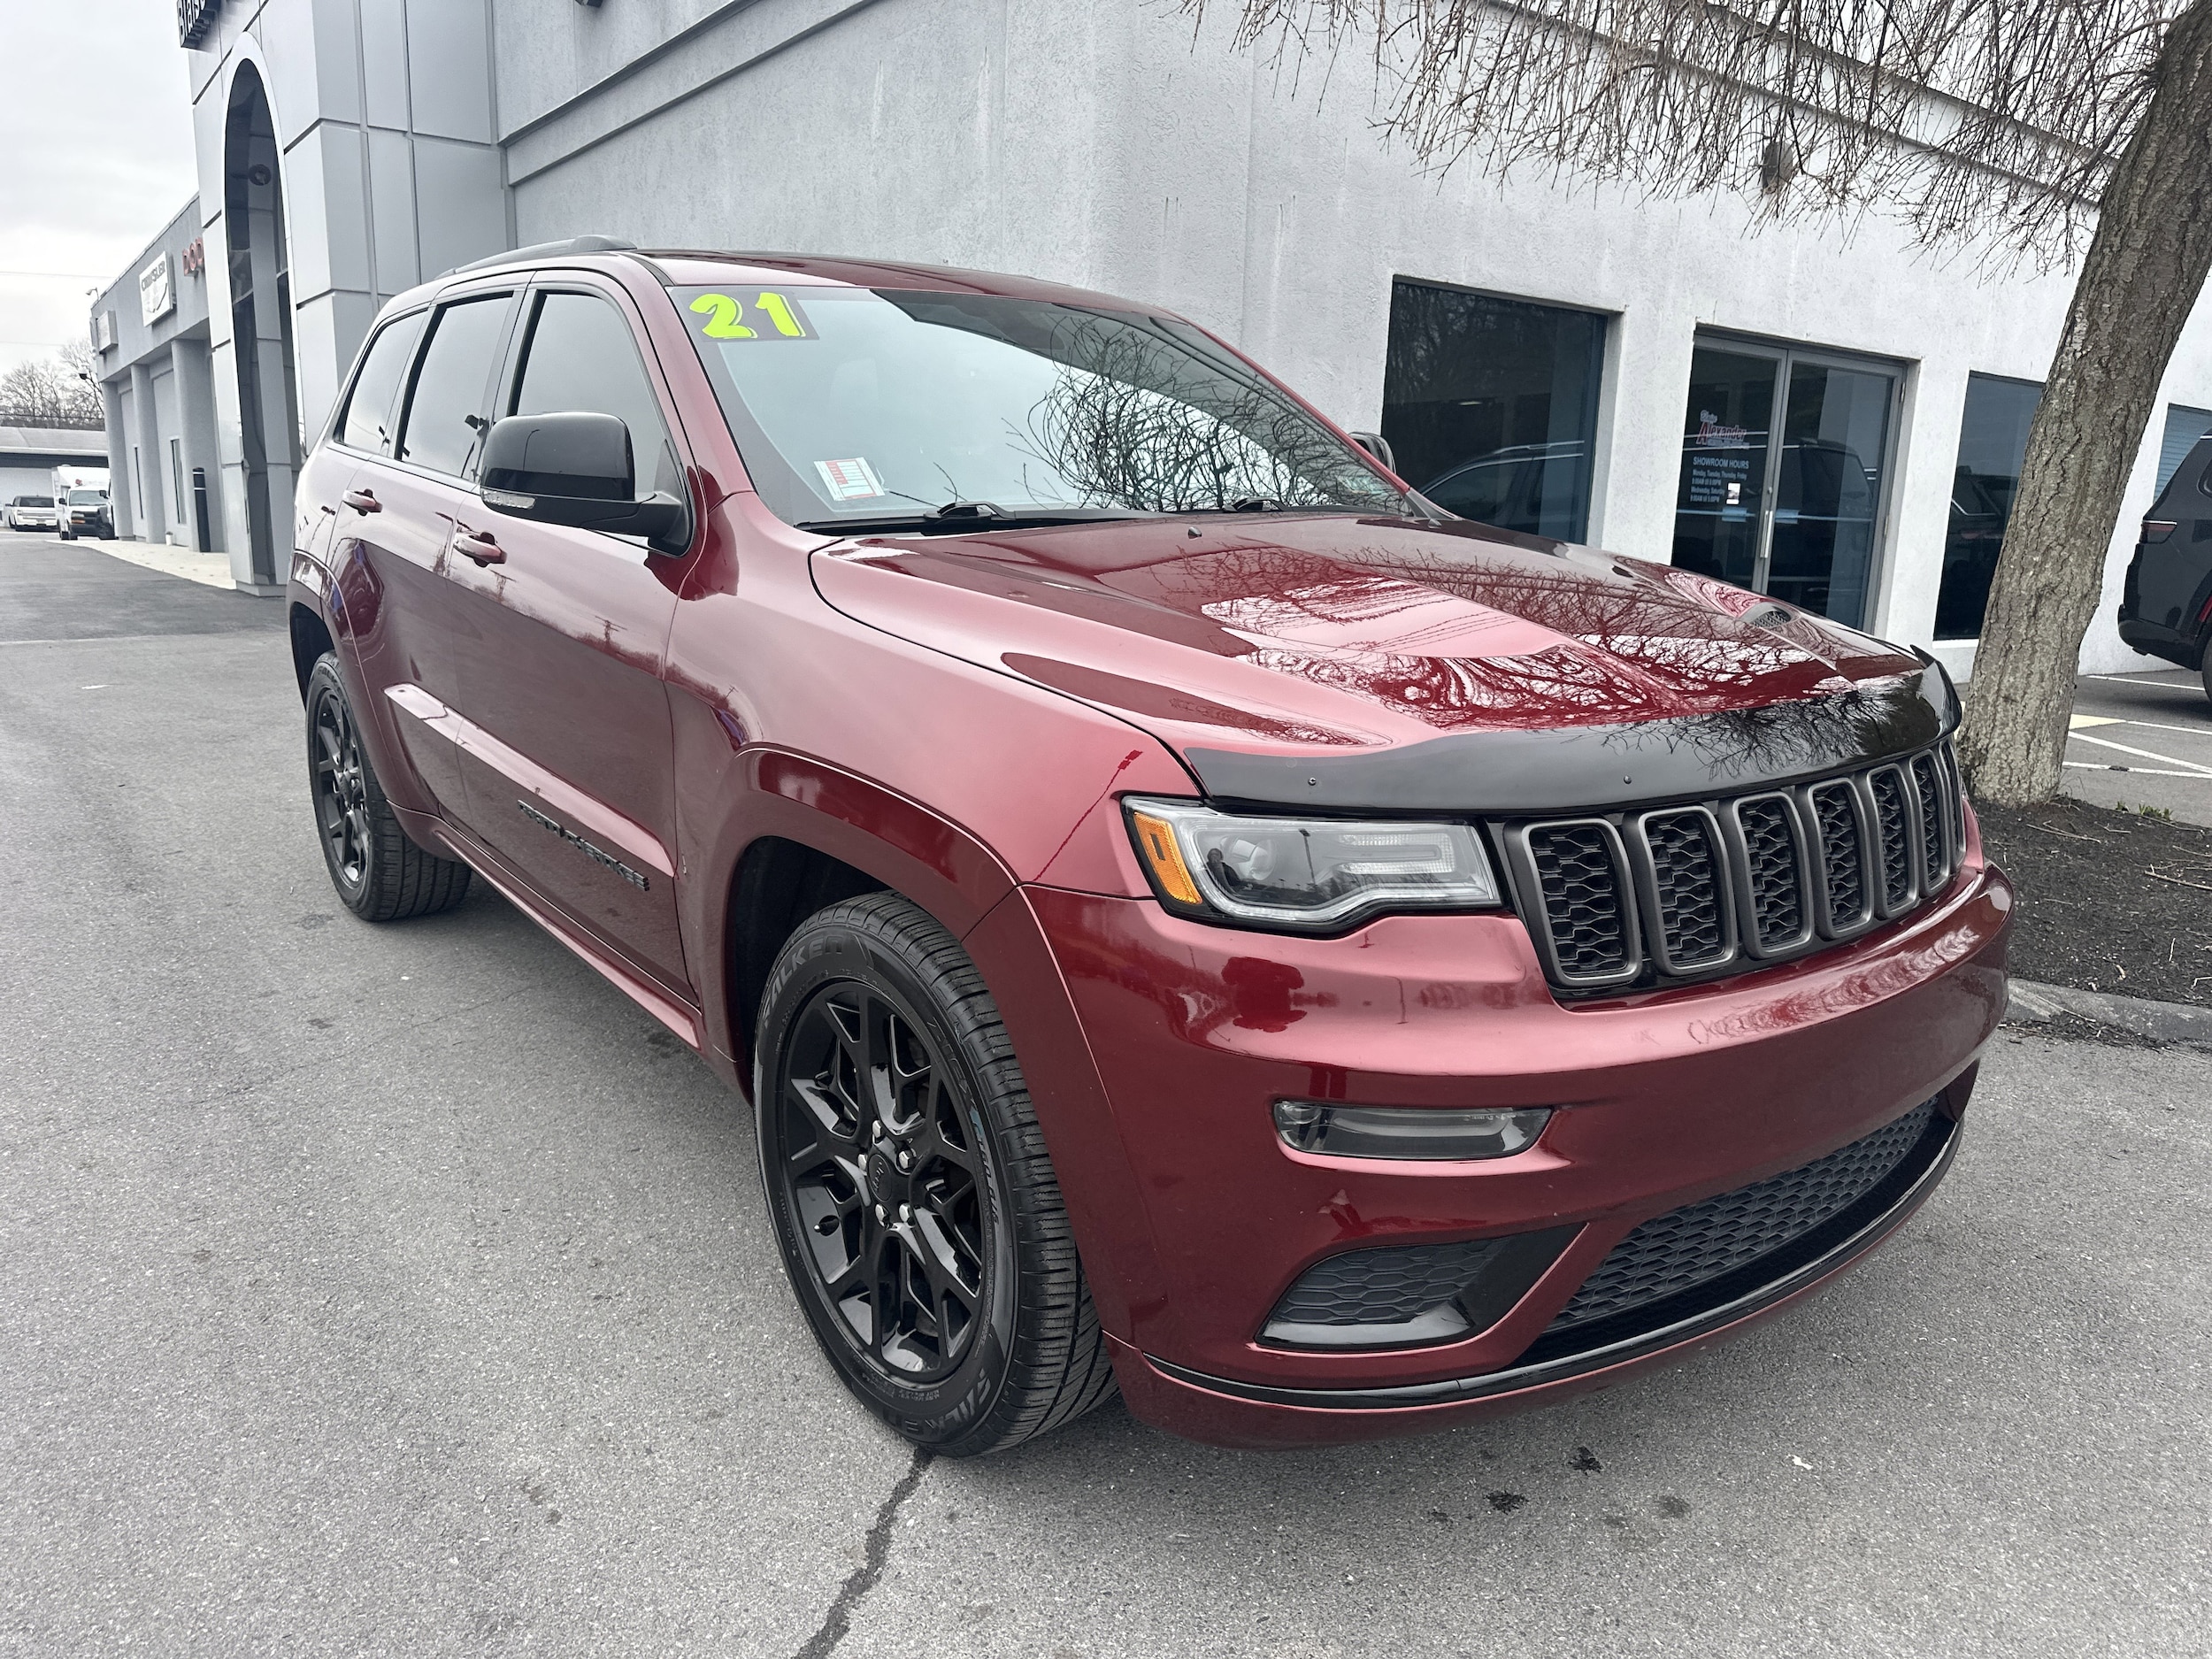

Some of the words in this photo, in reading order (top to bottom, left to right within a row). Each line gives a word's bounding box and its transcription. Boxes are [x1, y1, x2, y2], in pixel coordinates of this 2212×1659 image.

[689, 292, 806, 339] 21
[1696, 421, 1747, 445] Alexander
[1693, 456, 1728, 467] SHOWROOM
[1729, 459, 1749, 469] HOURS
[565, 829, 650, 892] CHEROKEE
[761, 935, 843, 1030] FALKEN
[872, 1160, 885, 1193] Jeep
